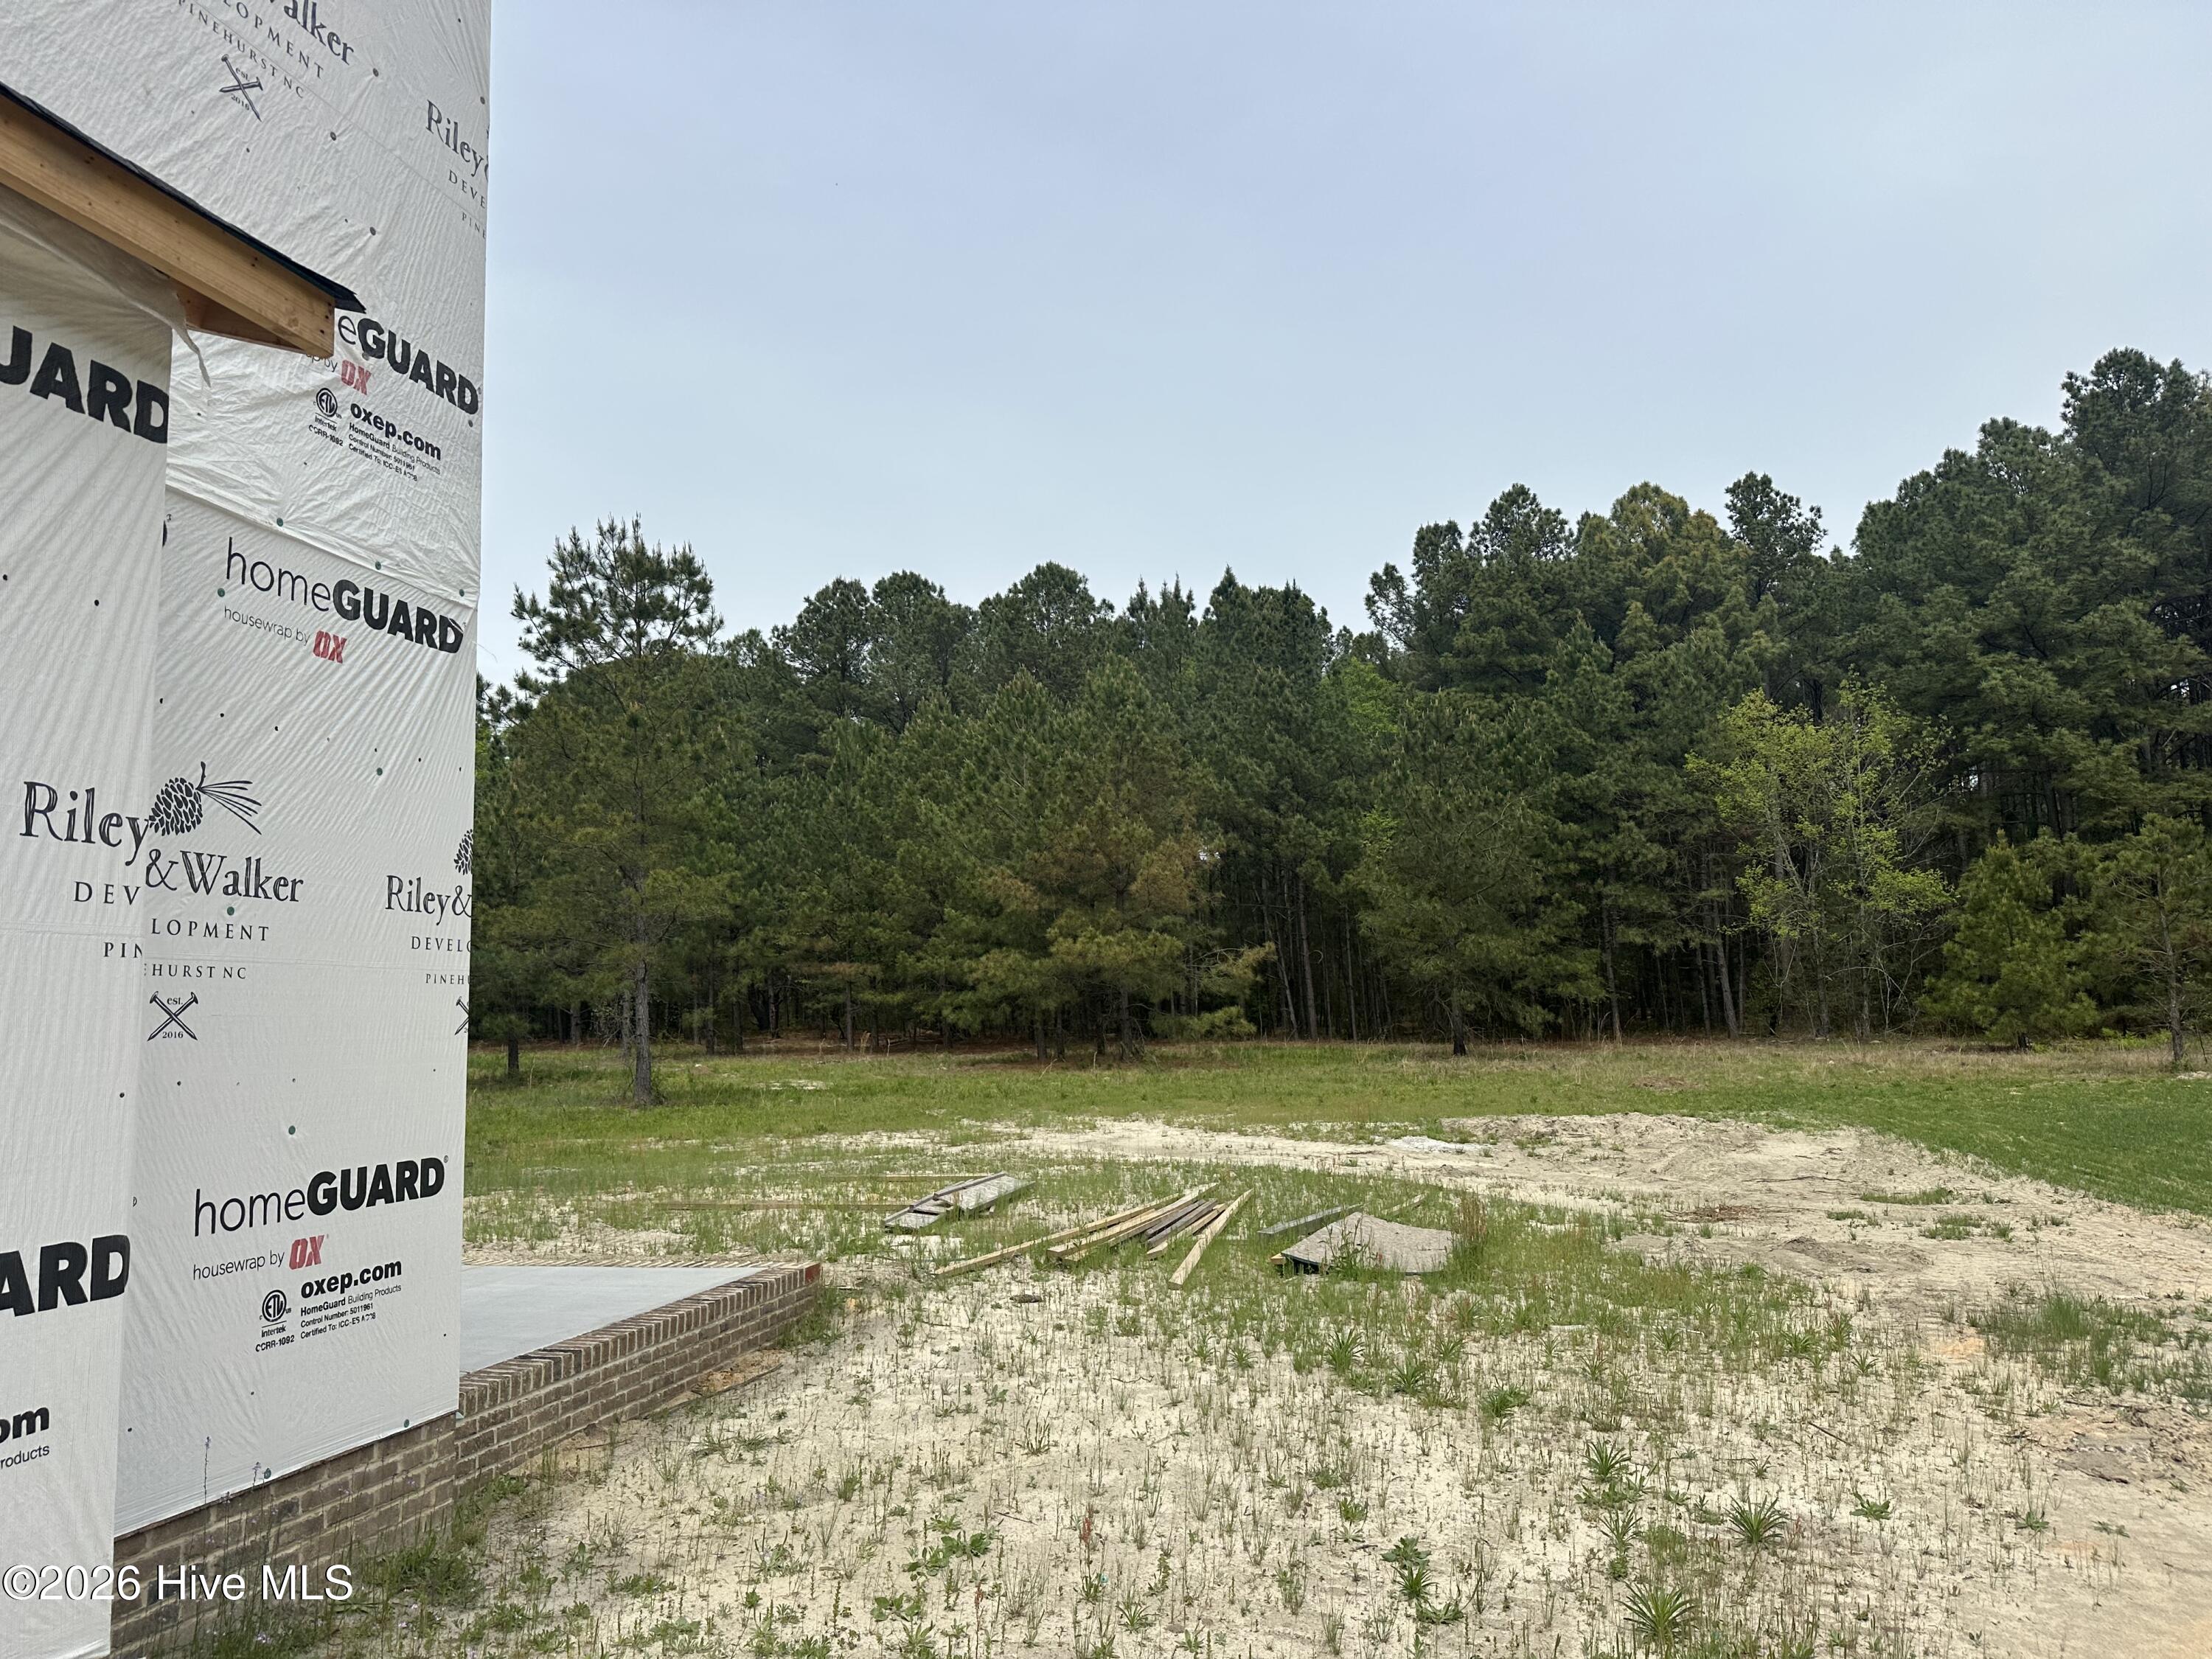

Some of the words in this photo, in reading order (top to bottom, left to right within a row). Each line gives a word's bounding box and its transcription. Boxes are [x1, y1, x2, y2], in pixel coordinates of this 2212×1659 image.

[268, 0, 354, 66] alker
[283, 76, 304, 99] NC
[448, 169, 486, 209] DEVE
[338, 315, 479, 415] eGUARD
[341, 359, 372, 395] OX
[314, 415, 337, 432] Intertek
[350, 403, 442, 461] oxep.com
[349, 434, 369, 449] Control
[349, 422, 391, 450] HomeGuard
[392, 444, 415, 464] Building
[416, 456, 441, 476] Products
[349, 443, 372, 460] Certified
[226, 536, 464, 654] homeGUARD
[223, 605, 293, 639] housewrap
[296, 627, 312, 647] by
[312, 630, 347, 664] OX
[19, 781, 149, 866] Riley
[74, 881, 141, 906] DEV
[151, 918, 270, 942] LOPMENT
[103, 942, 143, 959] PIN
[144, 963, 216, 978] HURST
[223, 966, 246, 979] NC
[167, 996, 184, 1005] est.
[162, 1031, 184, 1039] 2016
[195, 1156, 445, 1237] homeGUARD
[193, 1254, 265, 1281] housewrap
[270, 1249, 285, 1269] by
[288, 1234, 325, 1271] OX
[0, 1234, 131, 1317] ARD
[301, 1260, 402, 1299] oxep.com
[300, 1297, 347, 1317] HomeGuard
[348, 1290, 373, 1304] Building
[375, 1284, 402, 1298] Products
[300, 1316, 323, 1329] Control
[324, 1310, 349, 1321] Number:
[349, 1302, 374, 1315] 5011961
[261, 1324, 287, 1338] Intertek
[300, 1326, 327, 1340] Certified
[338, 1316, 361, 1329] ICC-ES
[255, 1334, 296, 1353] CCRR-1092
